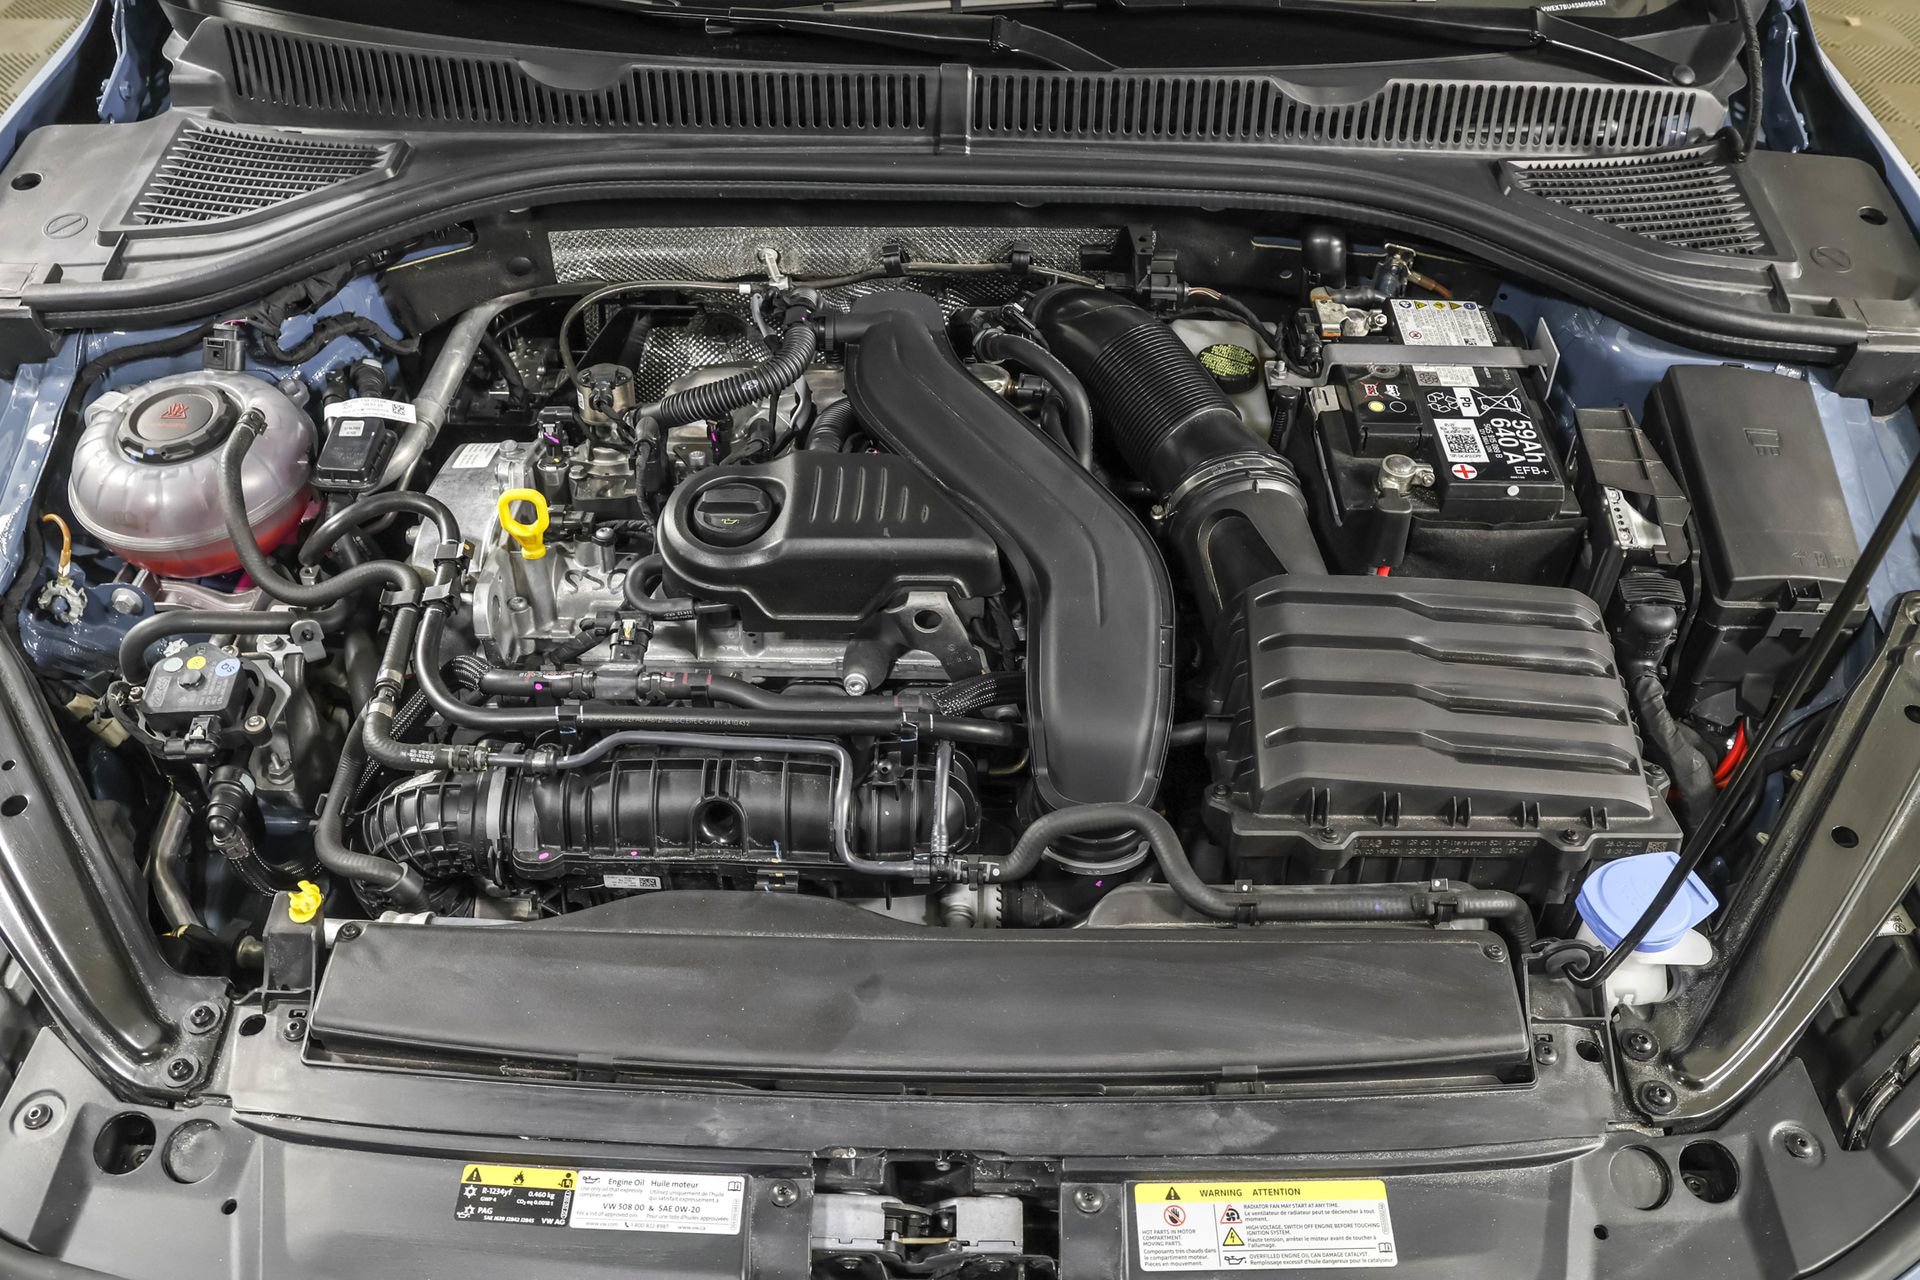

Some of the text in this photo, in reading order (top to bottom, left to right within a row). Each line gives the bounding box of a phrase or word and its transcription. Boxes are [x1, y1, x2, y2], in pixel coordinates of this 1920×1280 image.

[1460, 396, 1472, 408] Pb
[1490, 417, 1520, 448] 640
[1512, 419, 1546, 462] 59Ah
[1502, 450, 1526, 464] A
[1514, 466, 1549, 475] EFB+
[608, 1178, 632, 1187] Engine
[482, 1187, 513, 1197] R-1234yf
[1200, 1188, 1301, 1197] WARNING ATTENTION
